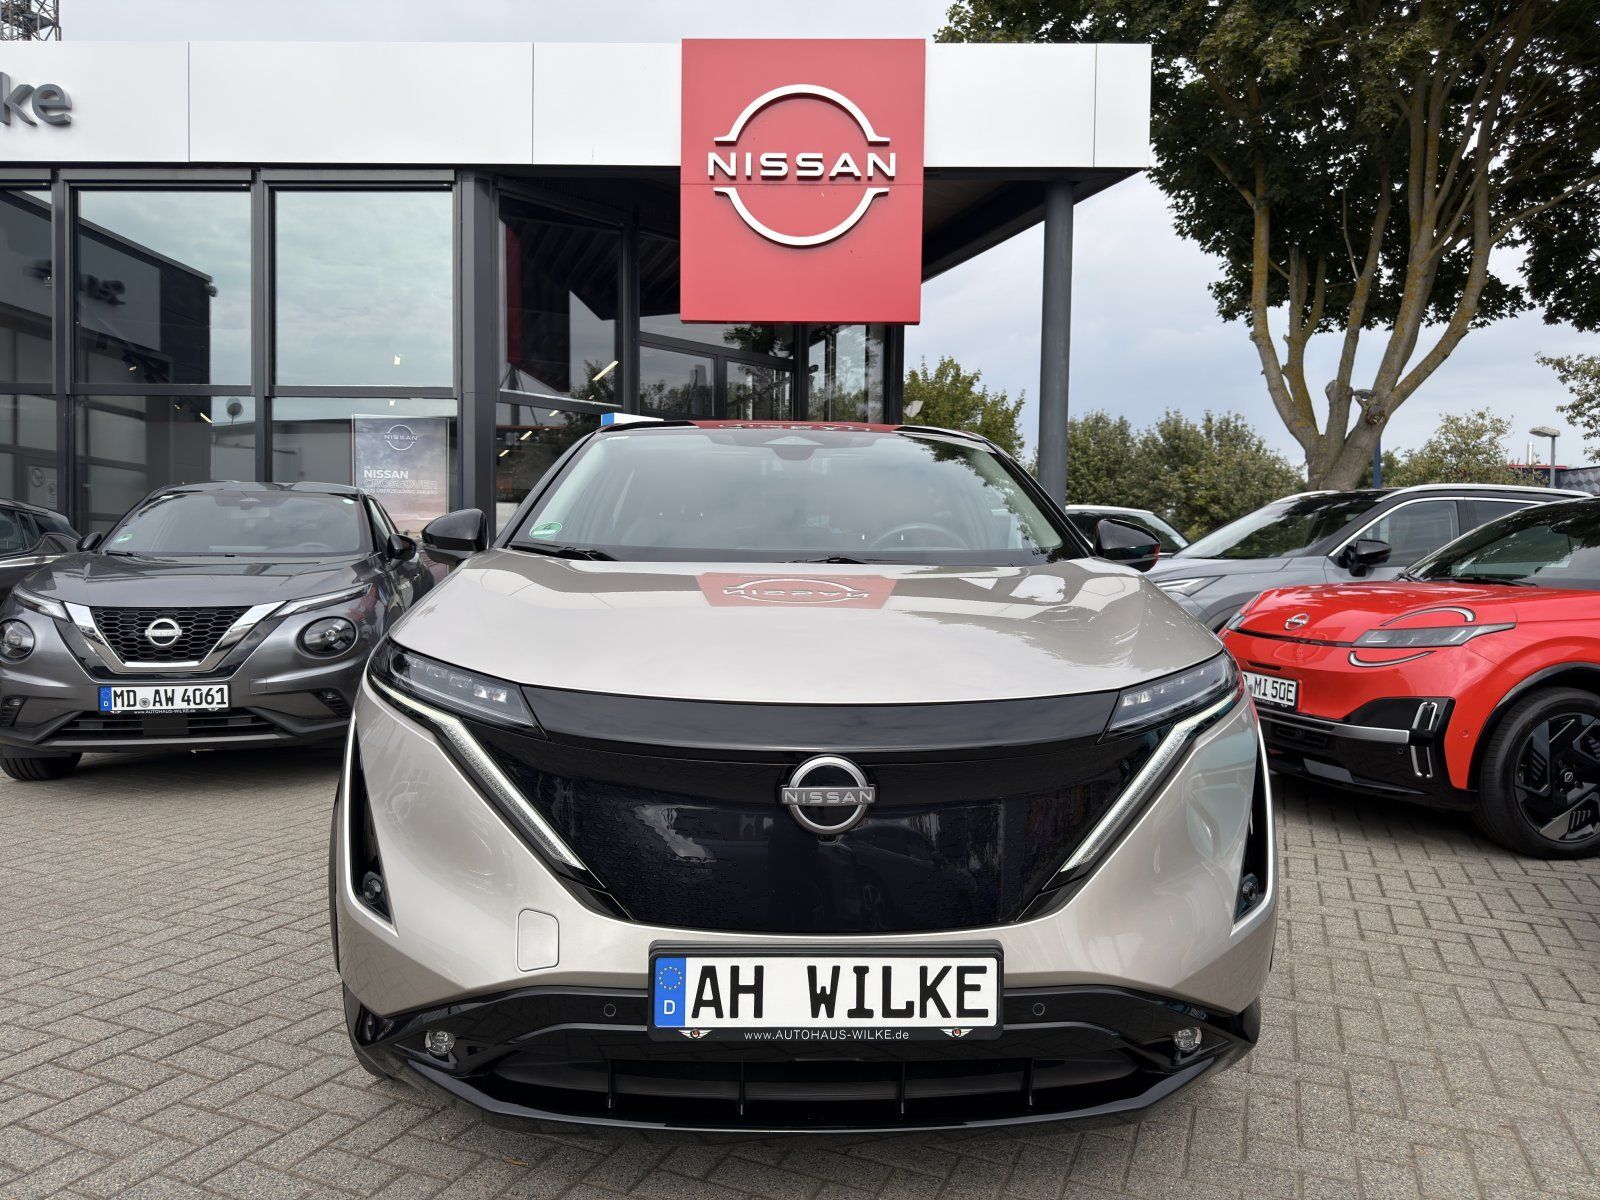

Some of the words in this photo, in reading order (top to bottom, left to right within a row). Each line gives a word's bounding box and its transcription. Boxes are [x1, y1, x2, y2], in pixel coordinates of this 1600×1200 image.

[708, 152, 897, 180] NISSAN
[364, 470, 409, 479] NISSAN
[363, 479, 438, 489] CROSSOVER
[113, 689, 137, 708] MD
[152, 688, 175, 707] AW
[181, 687, 227, 706] 4061
[783, 790, 873, 804] NISSAN
[691, 965, 765, 1019] AH
[807, 965, 989, 1019] WILKE
[663, 1000, 676, 1015] D
[744, 1029, 909, 1041] www.AUTOHAUS-WILKE.de
